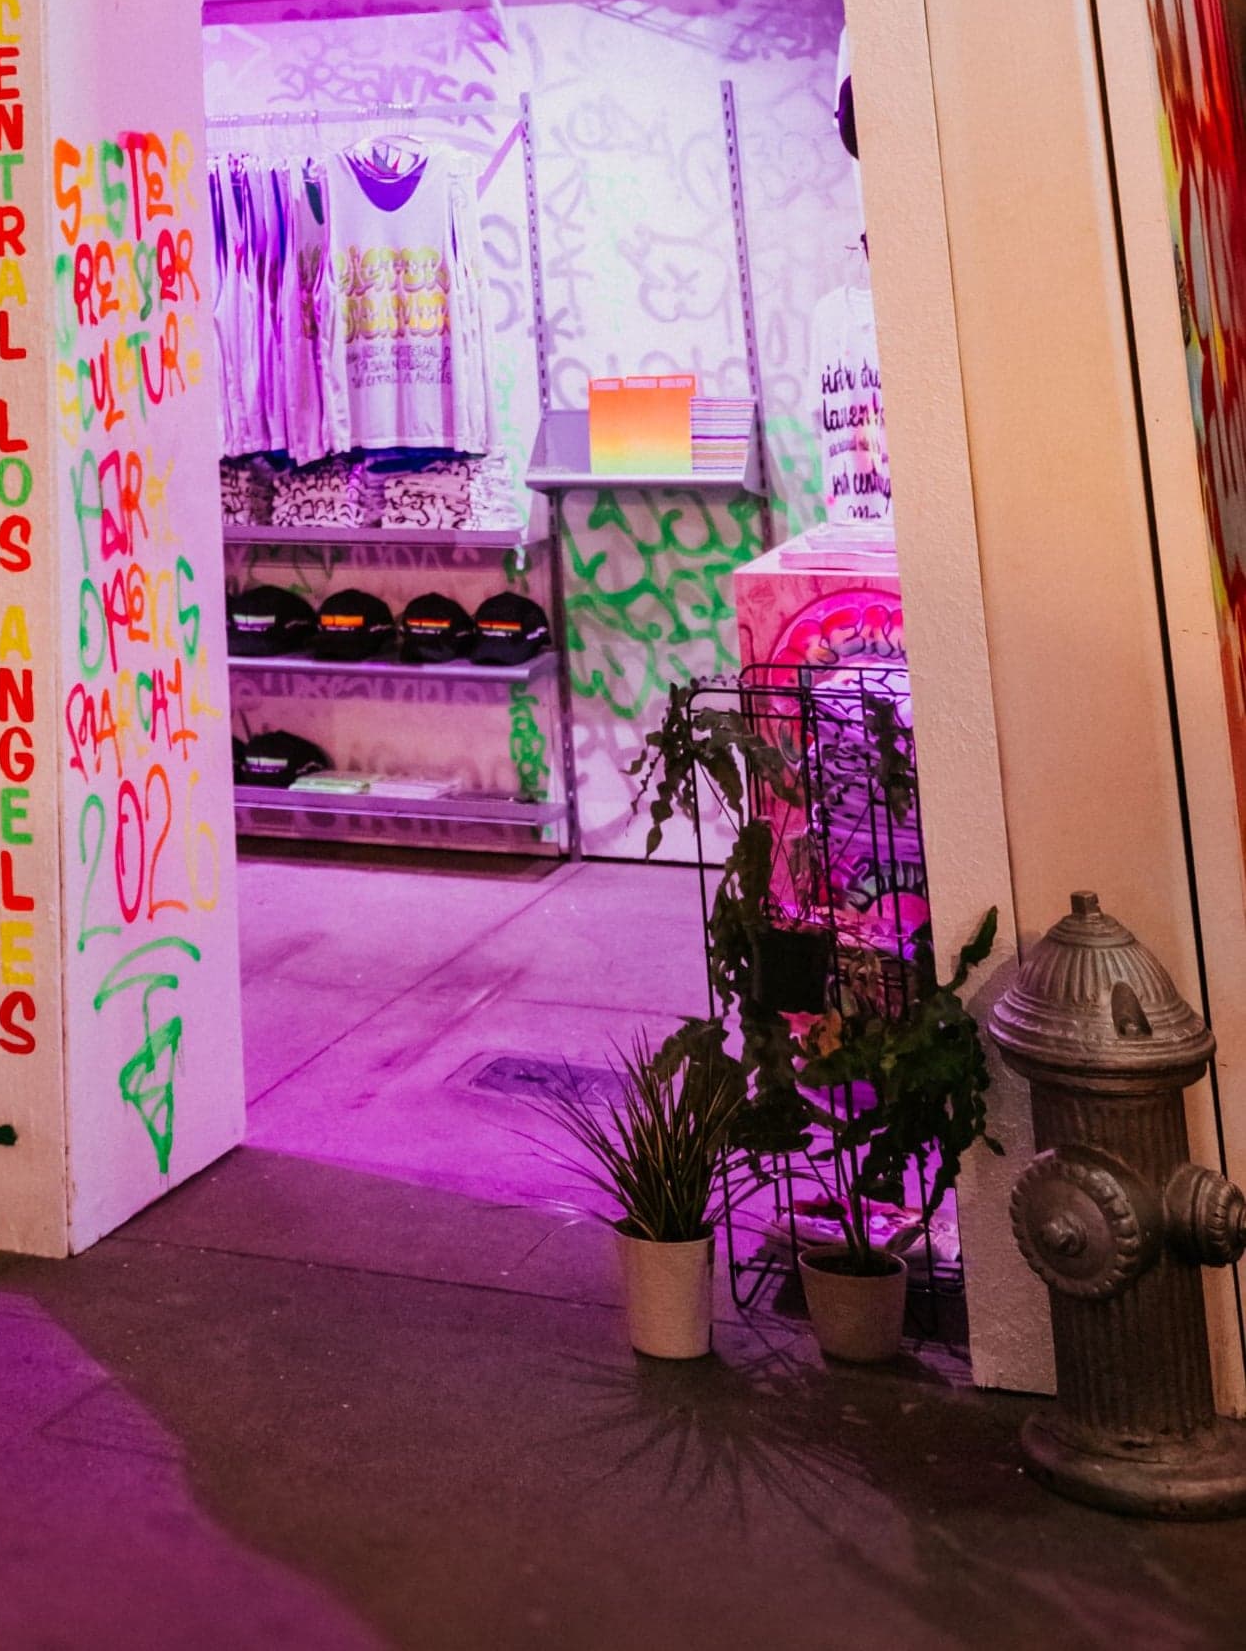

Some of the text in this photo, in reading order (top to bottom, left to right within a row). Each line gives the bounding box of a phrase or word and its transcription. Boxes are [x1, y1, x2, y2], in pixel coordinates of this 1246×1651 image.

[54, 129, 198, 246] SISTER
[55, 228, 201, 360] DREAMER
[57, 311, 202, 446] SCULPTURE
[70, 445, 184, 572] PARK
[78, 555, 201, 680] OPENS
[77, 763, 220, 953] 2026
